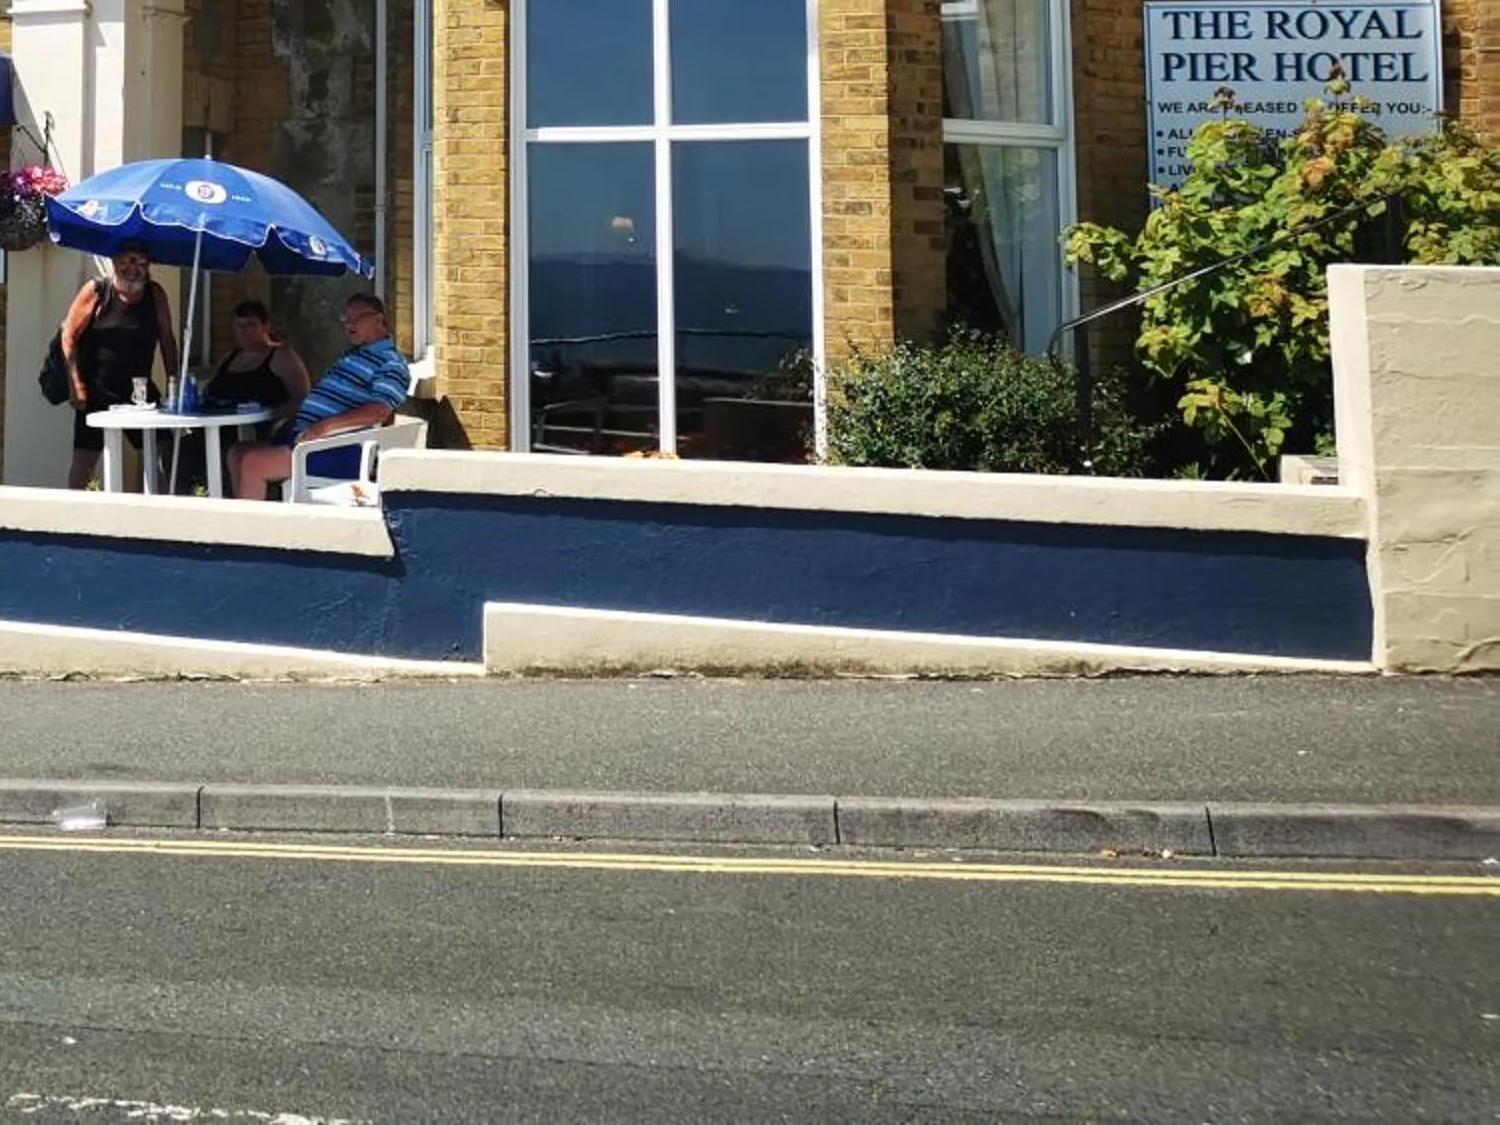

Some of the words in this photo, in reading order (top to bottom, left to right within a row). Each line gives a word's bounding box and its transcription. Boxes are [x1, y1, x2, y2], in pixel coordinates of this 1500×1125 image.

[1162, 10, 1253, 40] THE
[1264, 9, 1424, 40] ROYAL
[1158, 52, 1263, 83] PIER
[1273, 52, 1430, 83] HOTEL
[1157, 101, 1183, 114] WE
[1221, 101, 1297, 114] PEASED
